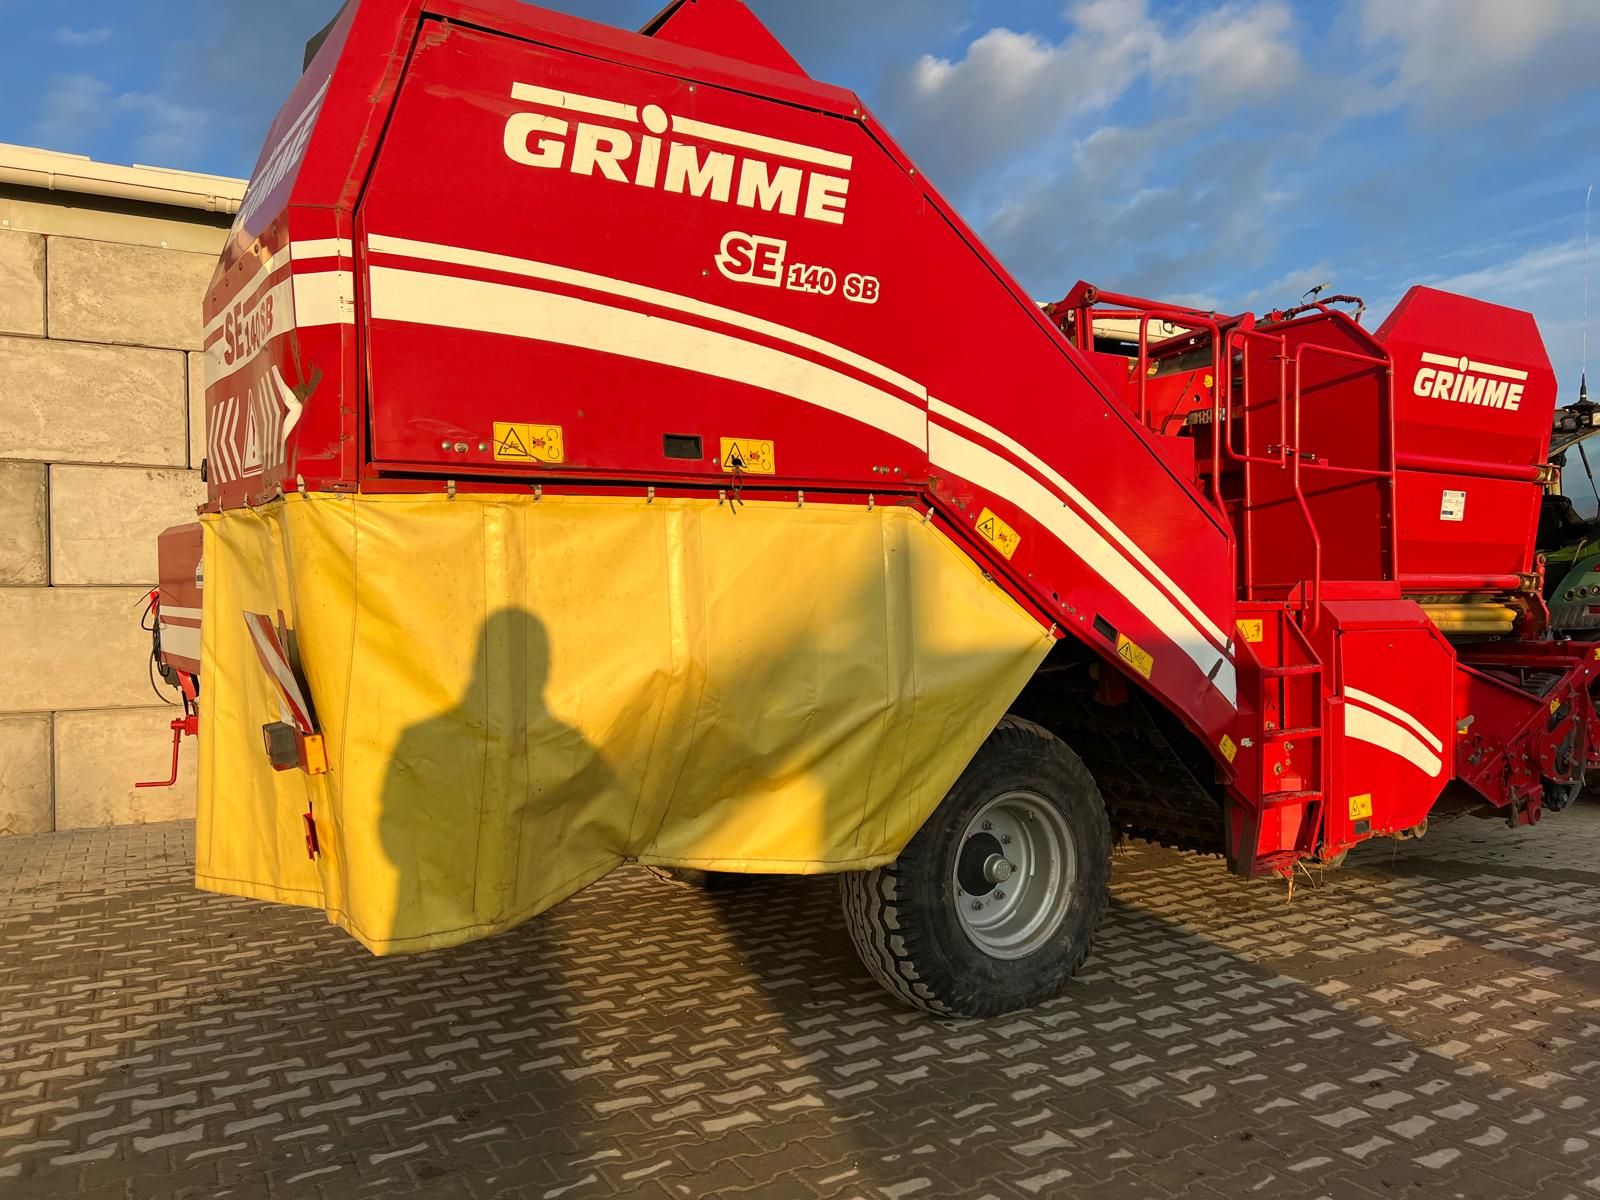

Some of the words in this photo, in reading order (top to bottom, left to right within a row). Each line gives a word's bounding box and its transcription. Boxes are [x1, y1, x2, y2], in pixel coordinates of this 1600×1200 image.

[503, 104, 850, 225] GRIMME
[718, 234, 784, 283] SE
[787, 264, 835, 294] 140
[844, 275, 879, 302] SB
[224, 301, 245, 366] SE
[1413, 356, 1525, 411] GRIMME
